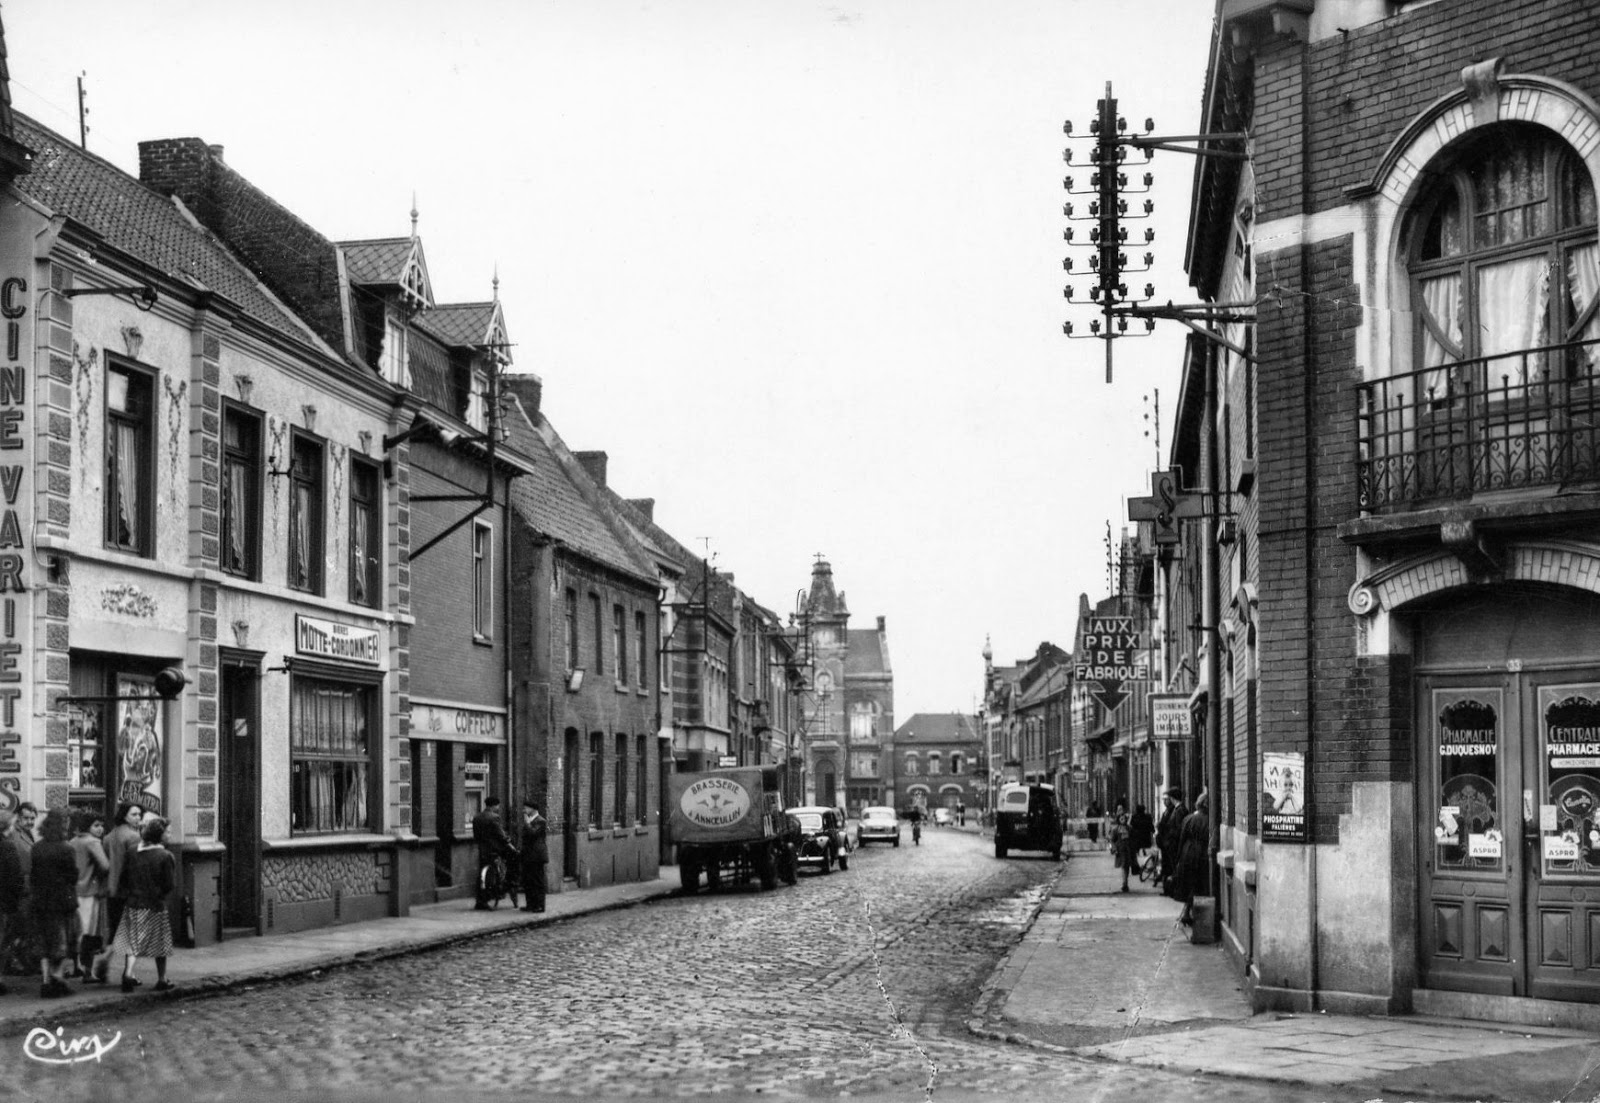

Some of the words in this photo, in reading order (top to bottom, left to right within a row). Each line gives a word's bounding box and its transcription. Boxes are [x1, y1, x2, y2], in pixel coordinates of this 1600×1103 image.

[1093, 619, 1129, 634] AUX
[300, 618, 379, 662] MOTTE-CORDONNIER
[1085, 635, 1137, 649] PRIX
[1097, 651, 1126, 665] DE
[1075, 666, 1147, 681] FABRIQUE
[1156, 712, 1188, 721] JOURS
[1156, 723, 1190, 732] IMPAIRS
[1442, 727, 1495, 743] PHARMACIE
[1547, 743, 1600, 755] PHARMACIE
[690, 780, 740, 795] BRASSERIE
[1473, 847, 1498, 855] ASPRO
[1549, 849, 1575, 857] ASPRO
